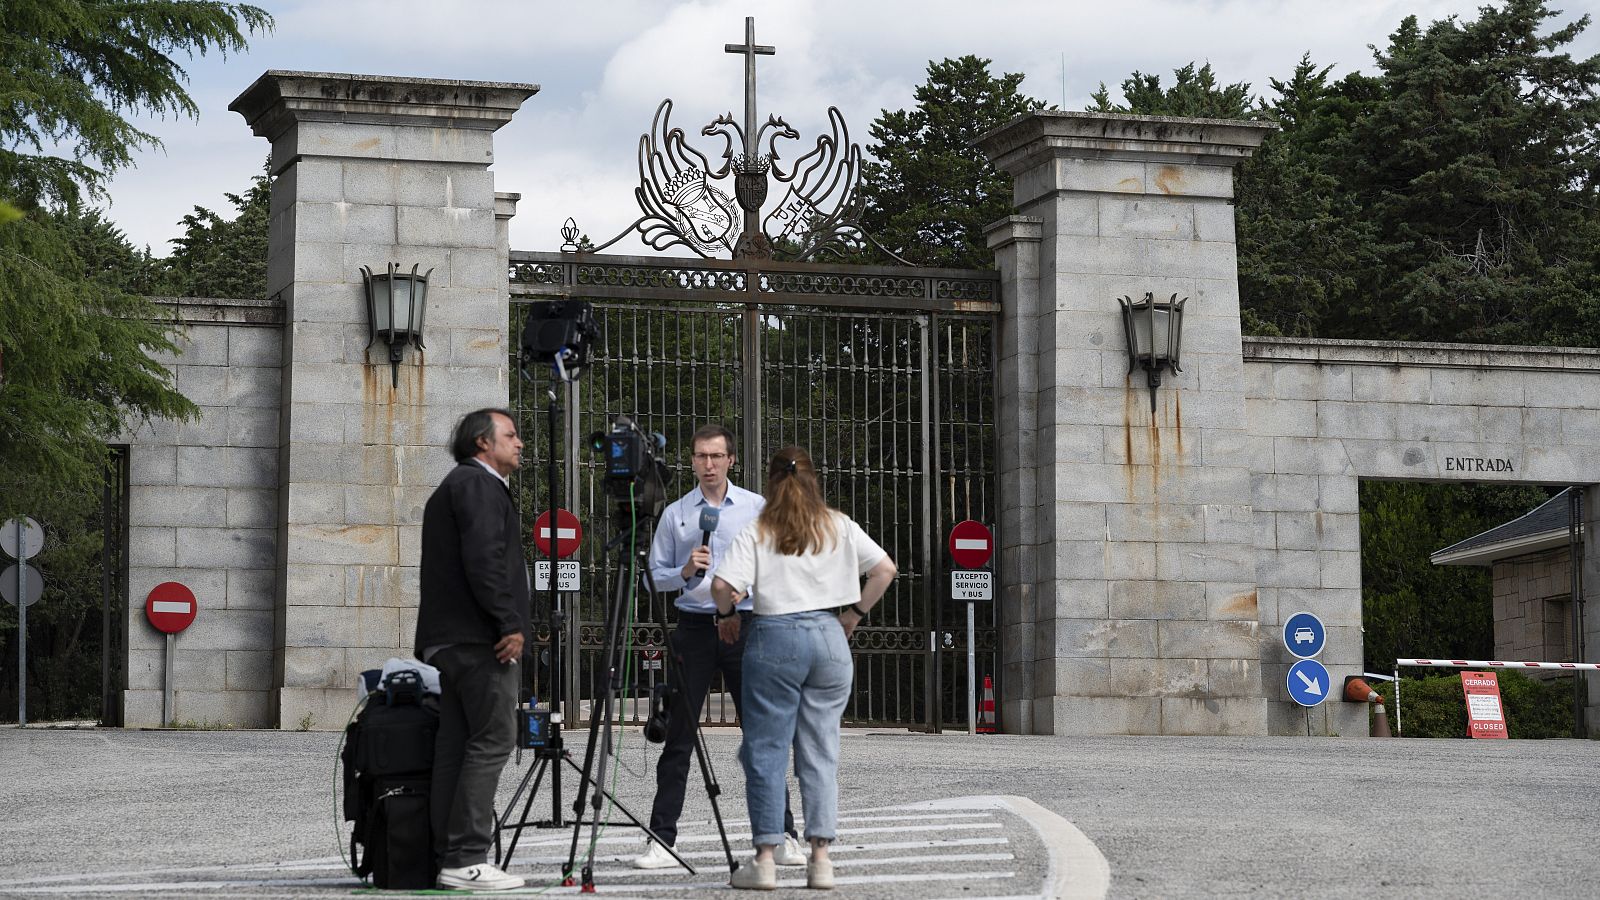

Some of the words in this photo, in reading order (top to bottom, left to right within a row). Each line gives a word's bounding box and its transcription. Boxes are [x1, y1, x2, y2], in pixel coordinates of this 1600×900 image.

[1445, 457, 1514, 472] ENTRADA
[955, 581, 989, 589] SERVICIO
[961, 590, 967, 598] Y
[1464, 679, 1496, 687] CERRADO
